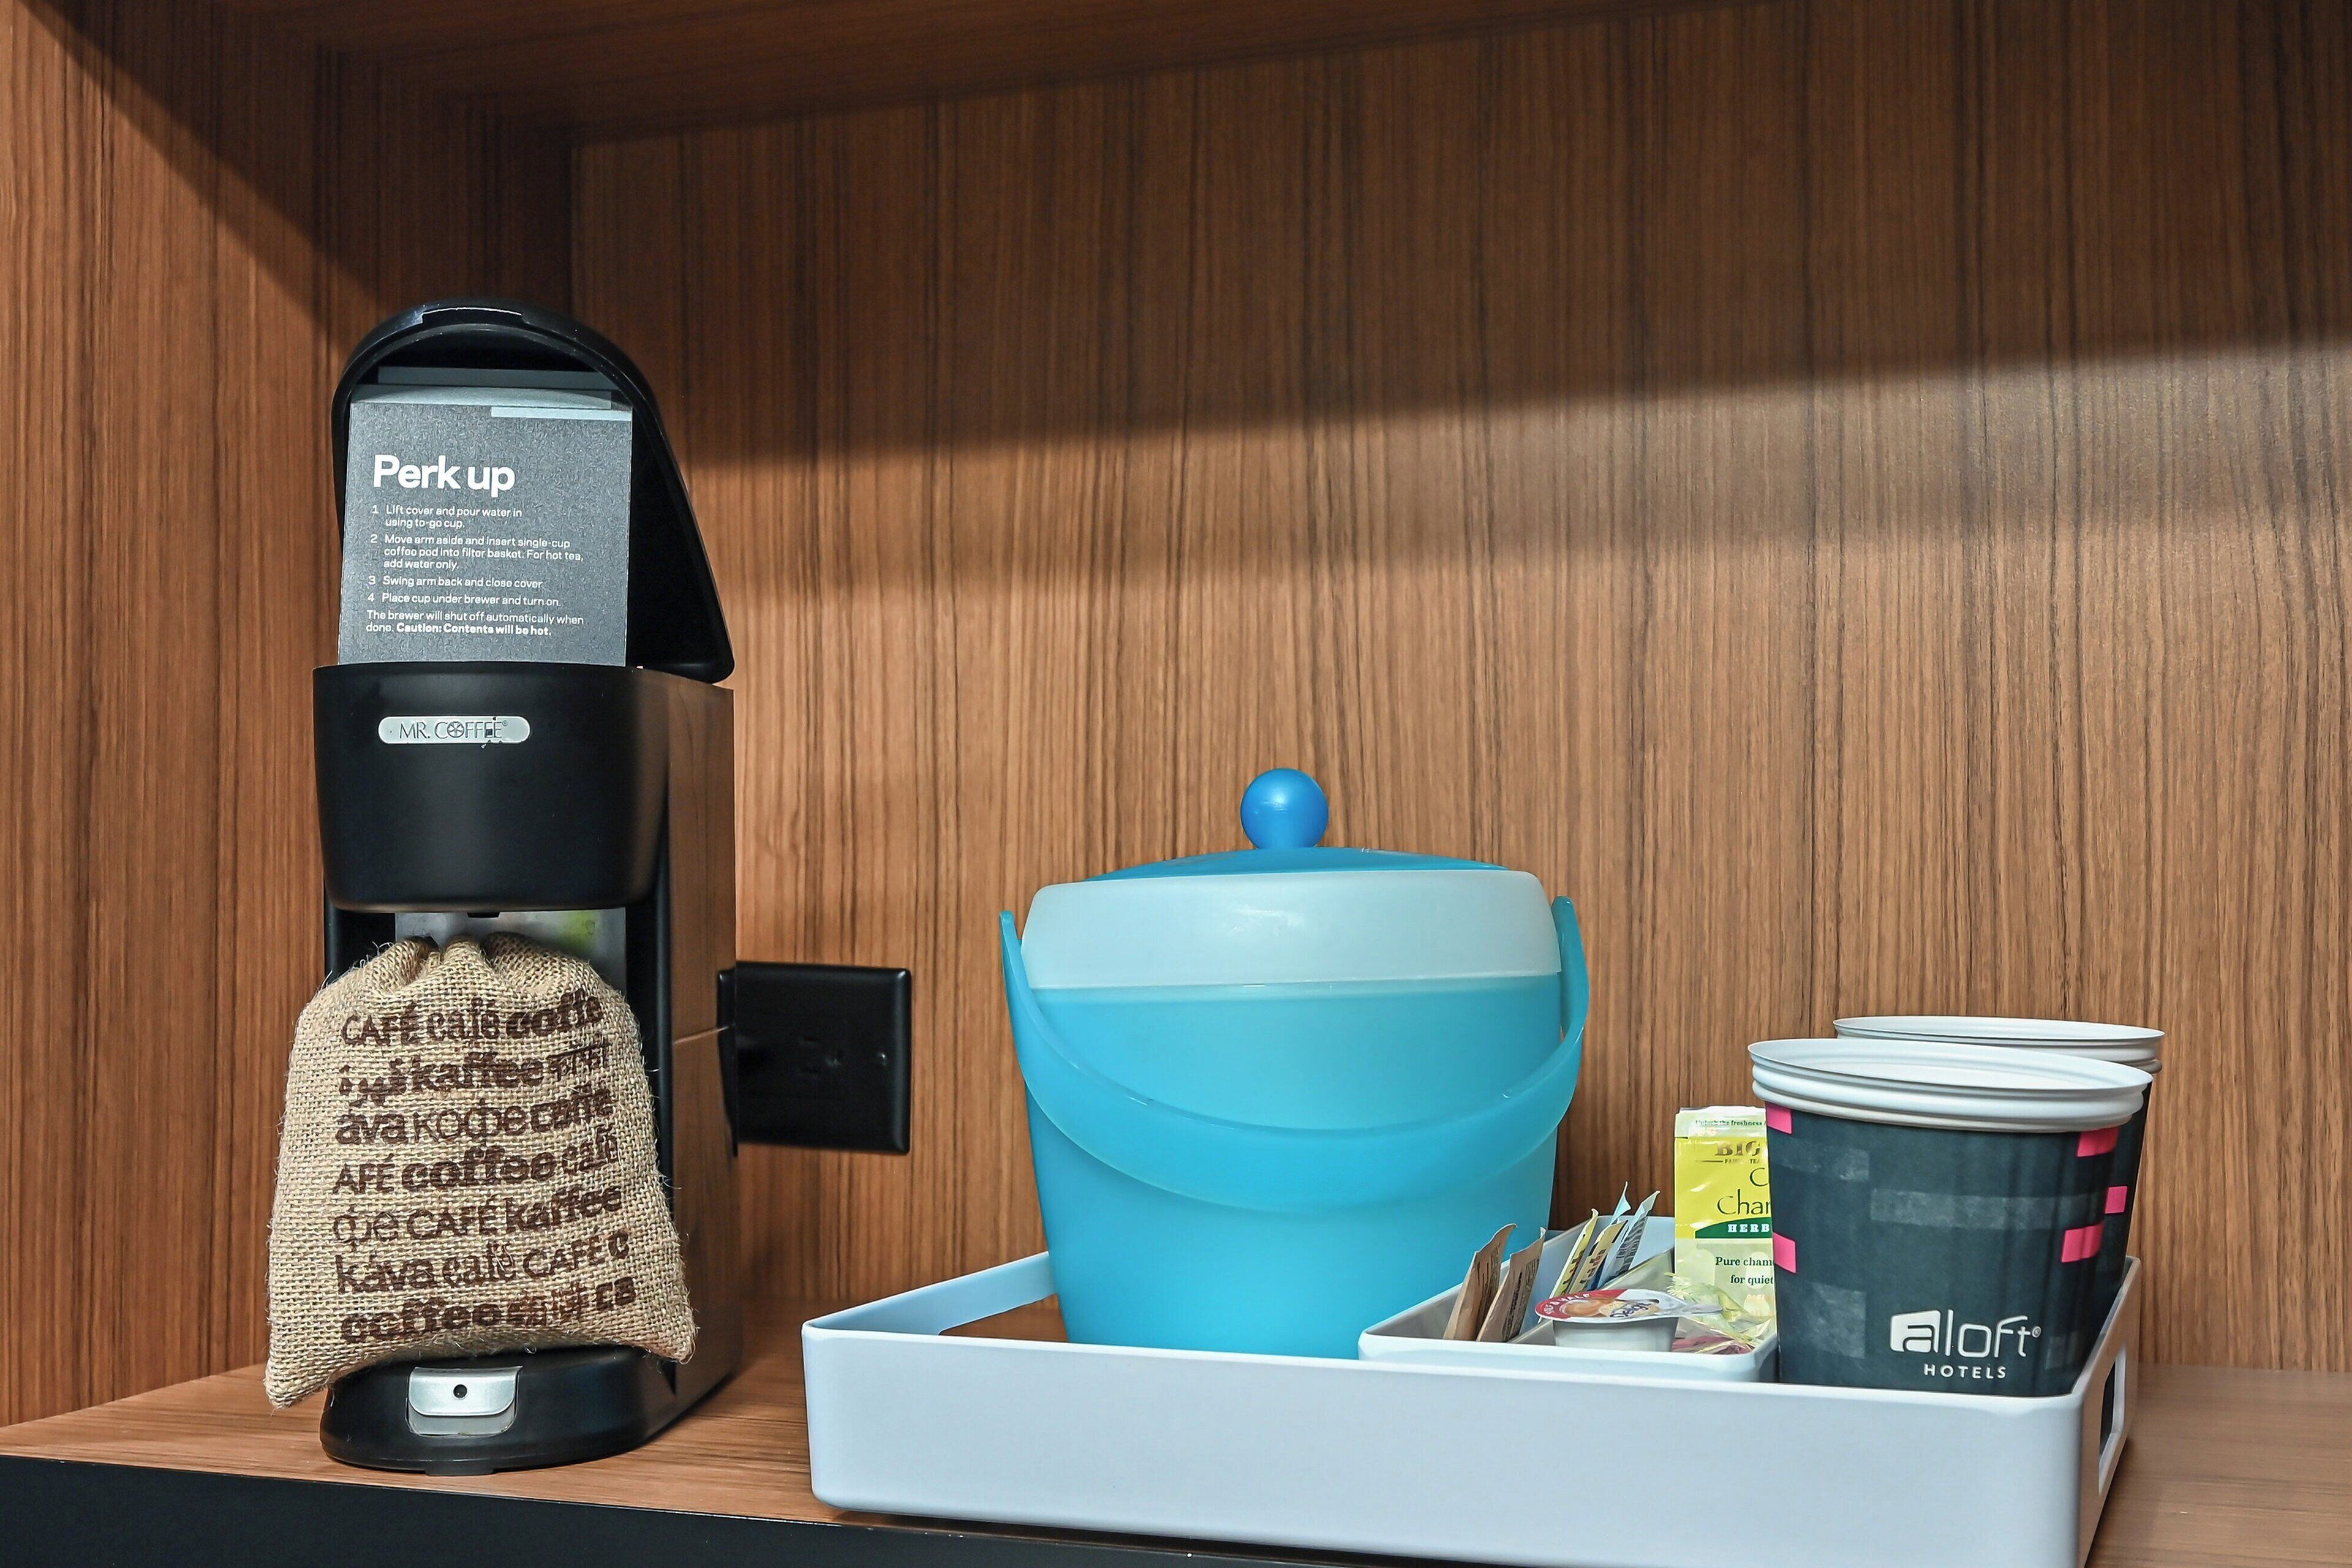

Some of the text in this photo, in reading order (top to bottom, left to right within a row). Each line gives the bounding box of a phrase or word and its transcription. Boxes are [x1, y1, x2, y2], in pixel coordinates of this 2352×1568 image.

[373, 454, 516, 498] Perk up
[371, 505, 379, 514] 1
[386, 505, 404, 515] Lift
[435, 506, 454, 515] and
[457, 509, 480, 519] pour
[482, 508, 510, 516] water
[513, 508, 522, 517] in
[385, 519, 413, 529] using
[415, 519, 442, 529] to-go
[370, 533, 378, 543] 2
[385, 534, 412, 544] Move
[436, 535, 463, 545] aside
[465, 535, 484, 545] and
[486, 536, 516, 546] insert
[518, 538, 570, 549] single-cup
[384, 546, 584, 562] coffee pod into filter basket. For hot tea,
[383, 559, 459, 571] add water only.
[368, 575, 376, 585] 3
[383, 575, 415, 587] Swing
[438, 576, 462, 586] back
[464, 577, 484, 587] and
[486, 577, 512, 587] close
[368, 592, 375, 602] 4
[382, 593, 410, 603] Place
[412, 595, 431, 605] cup
[432, 594, 462, 603] under
[464, 594, 500, 604] brewer
[502, 595, 521, 605] and
[523, 597, 545, 606] turn
[367, 610, 584, 625] The brewer will shut off automatically when
[366, 622, 552, 636] done. Caution: Contents will be hot.
[399, 722, 431, 739] MR.
[342, 1001, 420, 1046] CAFÉ
[411, 1050, 544, 1092] kaffee
[412, 1101, 528, 1147] кофе
[333, 1153, 396, 1194] AFÉ
[401, 1146, 557, 1189] coffee
[407, 1198, 497, 1240] CAFÉ
[505, 1186, 622, 1232] kaffee
[1727, 1224, 1770, 1233] HERB
[523, 1229, 607, 1279] CAFÉ
[1716, 1256, 1741, 1266] Pure
[1730, 1274, 1746, 1284] for
[342, 1296, 503, 1342] coffee
[1923, 1363, 2007, 1379] HOTELS
